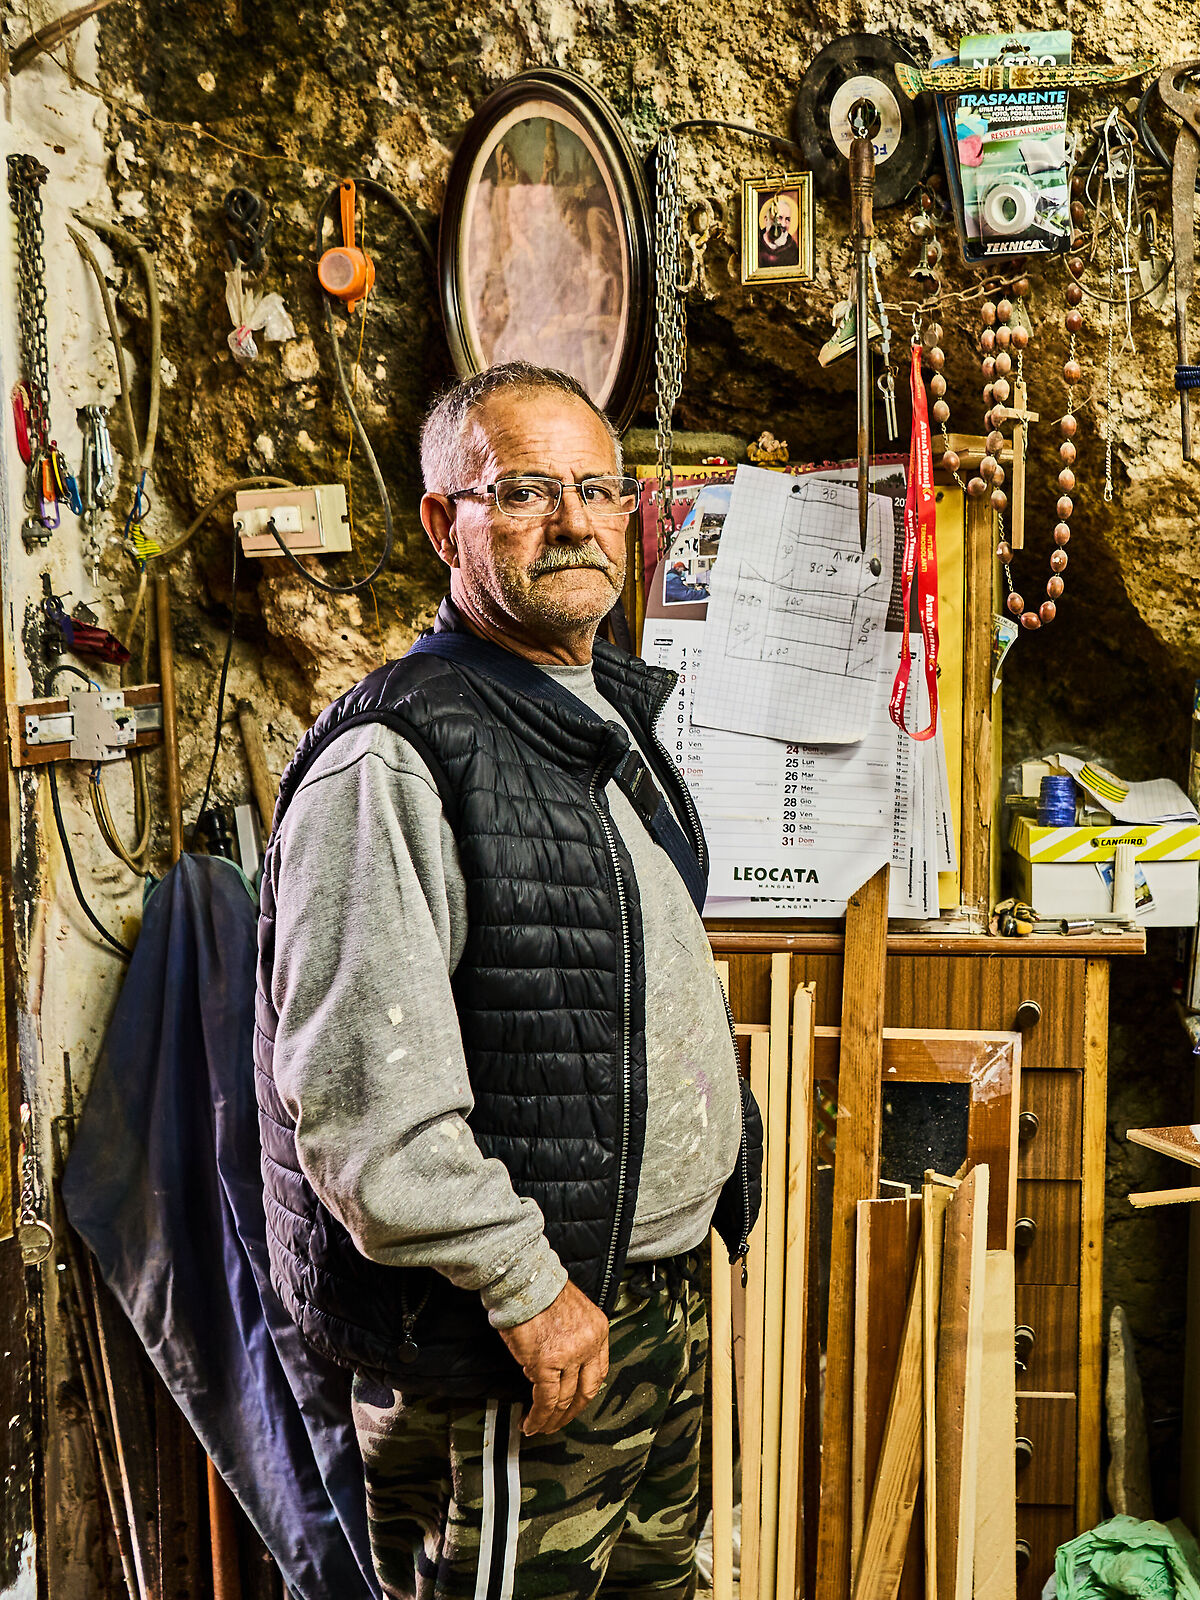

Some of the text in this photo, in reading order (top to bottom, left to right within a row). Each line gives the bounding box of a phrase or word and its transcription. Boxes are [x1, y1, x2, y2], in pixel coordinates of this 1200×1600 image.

[973, 55, 1057, 69] NSTRO
[959, 91, 1066, 106] TRASPARENTE
[991, 131, 1017, 140] RESISTE
[985, 240, 1041, 252] TEKNICA
[822, 487, 838, 501] 30
[681, 648, 686, 656] 1
[680, 661, 687, 670] 2
[679, 674, 686, 683] 3
[678, 687, 685, 696] 4
[678, 701, 684, 710] 5
[677, 714, 684, 723] 6
[677, 727, 683, 737] 7
[676, 741, 683, 750] 8
[786, 745, 799, 755] 24
[675, 754, 682, 764] 9
[785, 758, 798, 768] 25
[785, 771, 798, 781] 26
[784, 784, 797, 794] 27
[783, 797, 797, 807] 28
[783, 811, 796, 820] 29
[782, 823, 795, 833] 30
[782, 837, 794, 846] 31
[733, 866, 819, 884] LEOCATA
